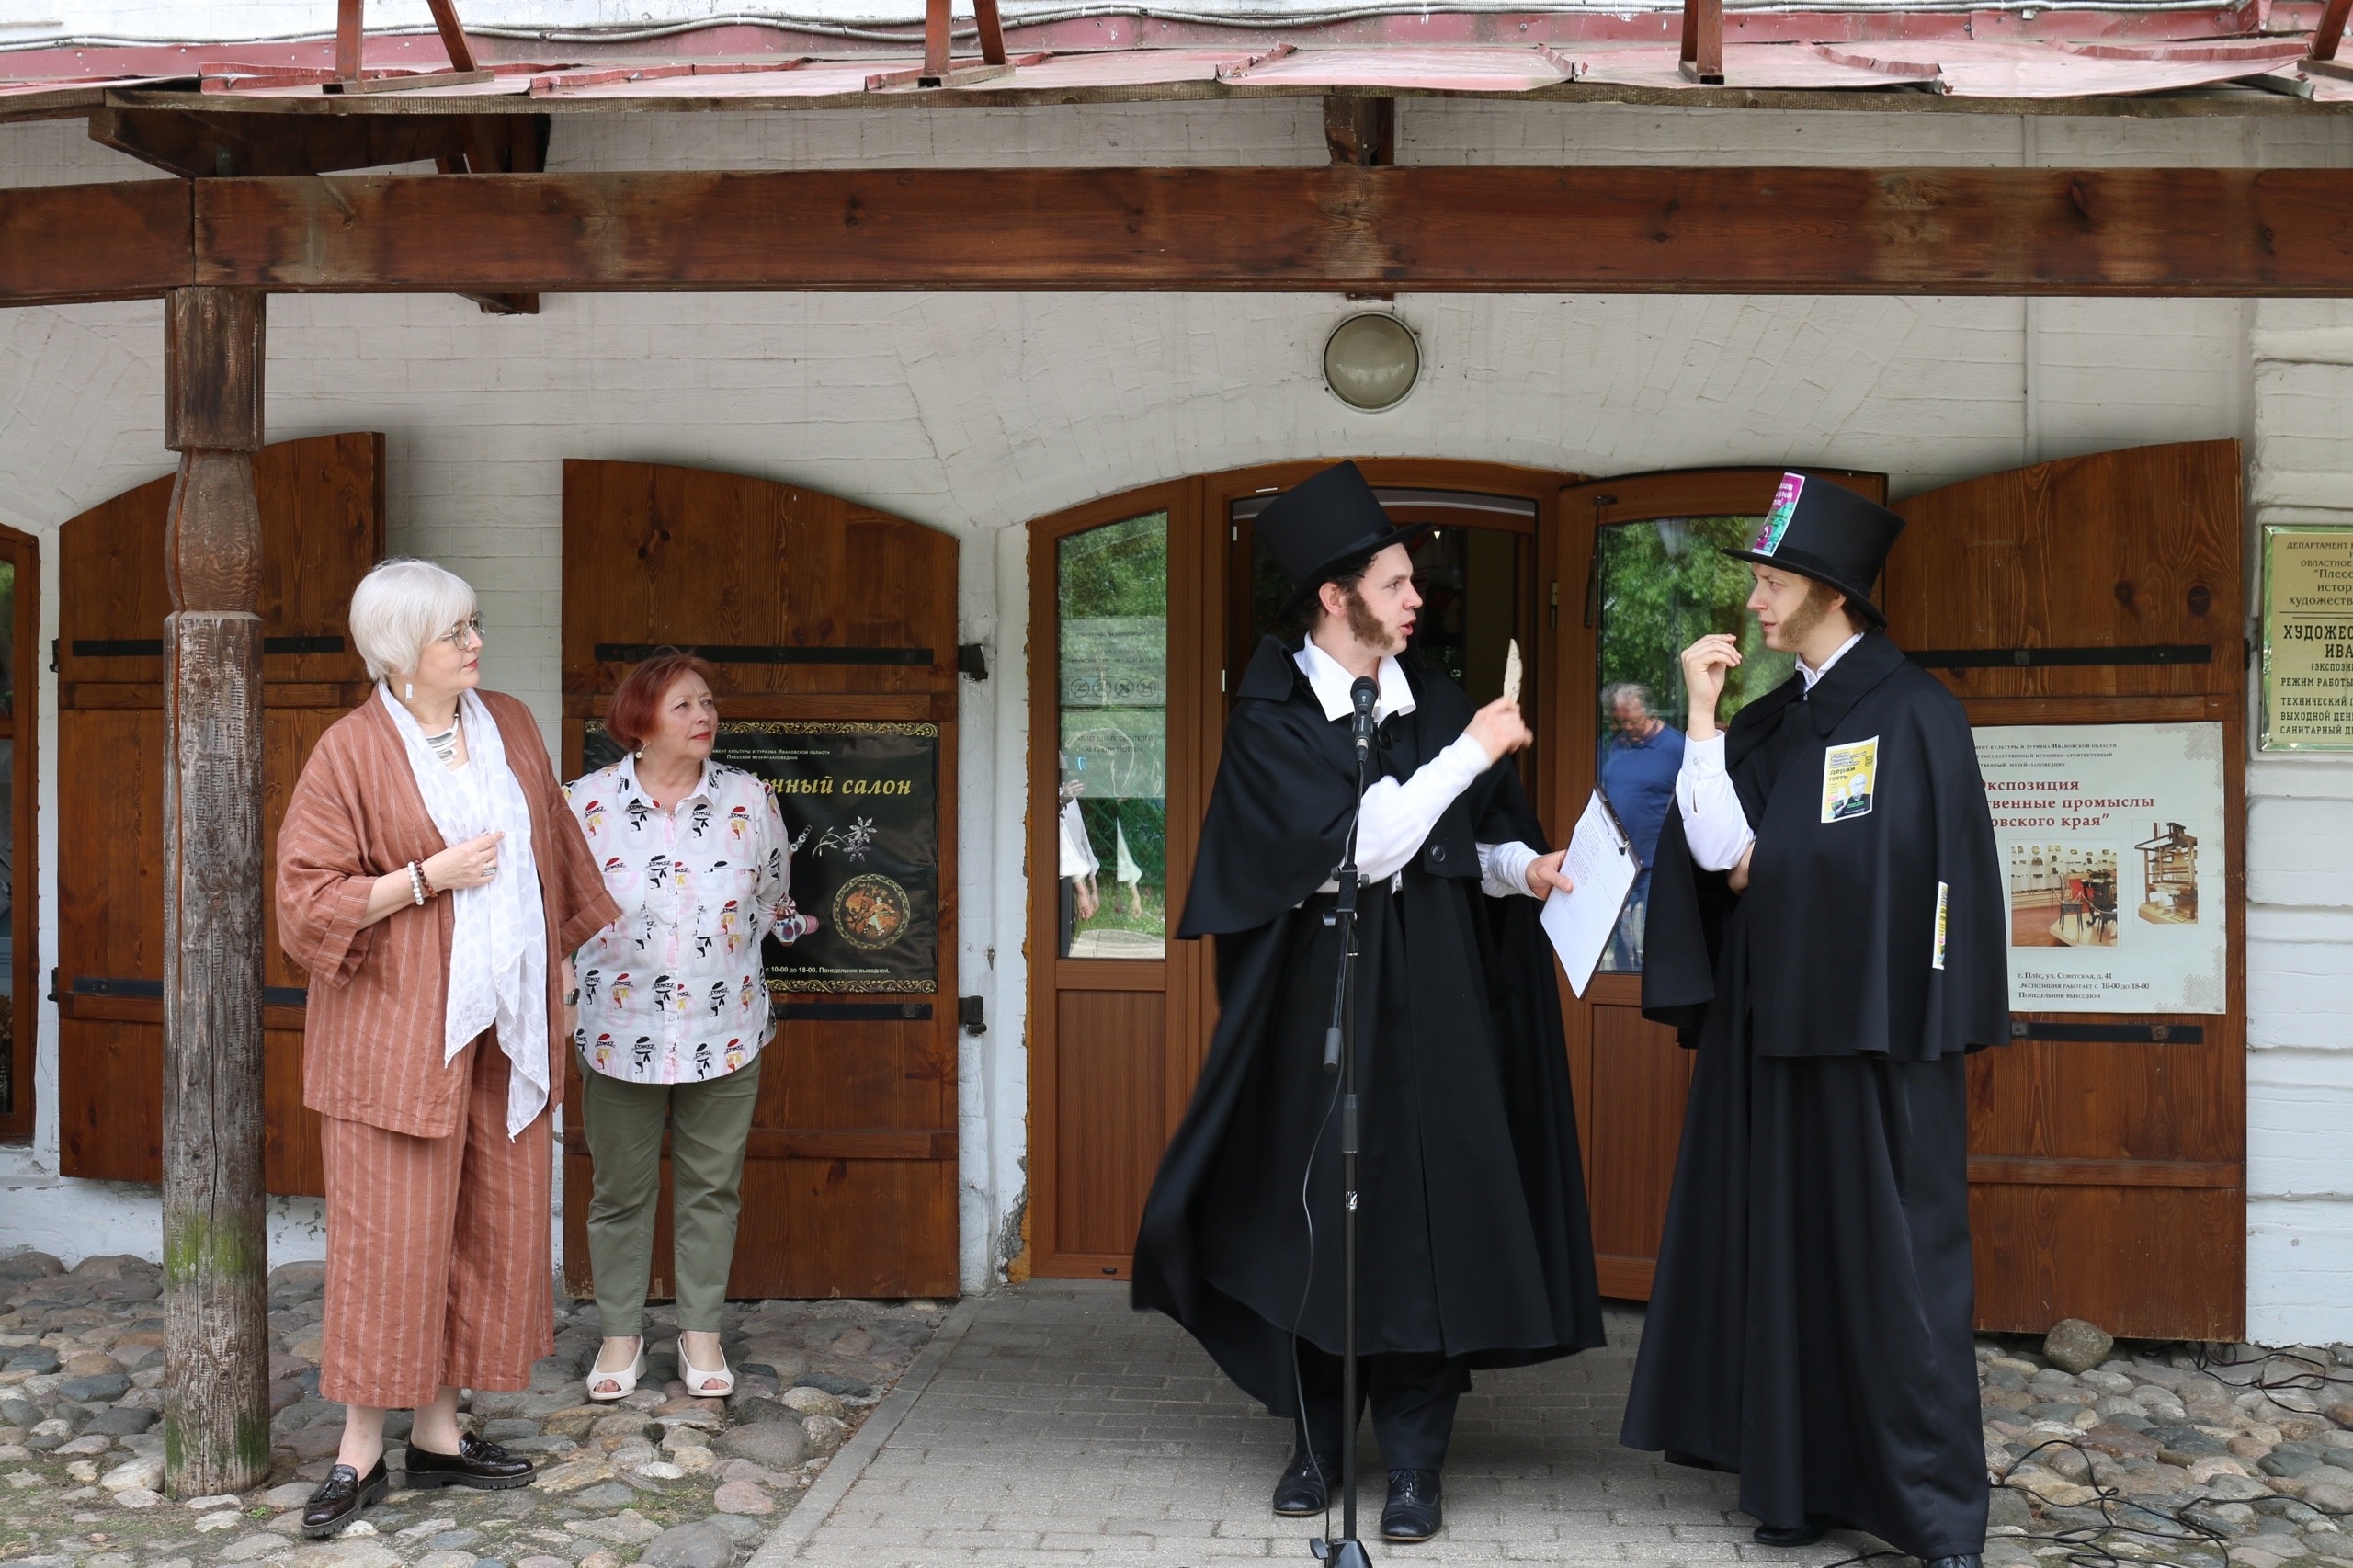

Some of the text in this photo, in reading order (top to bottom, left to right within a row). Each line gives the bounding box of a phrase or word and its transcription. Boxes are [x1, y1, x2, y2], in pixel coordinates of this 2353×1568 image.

[2311, 663, 2353, 672] (ЭКСПОЗИ
[2281, 678, 2353, 687] РЕЖИМ РАБОТЫ
[2280, 696, 2347, 706] ТЕХНИЧЕСКИЙ
[2280, 710, 2353, 722] ВЫХОДНОЙ ДЕН
[2280, 724, 2341, 734] САНИТАРНЫЙ
[842, 779, 912, 795] салон
[2062, 798, 2155, 812] промыслы
